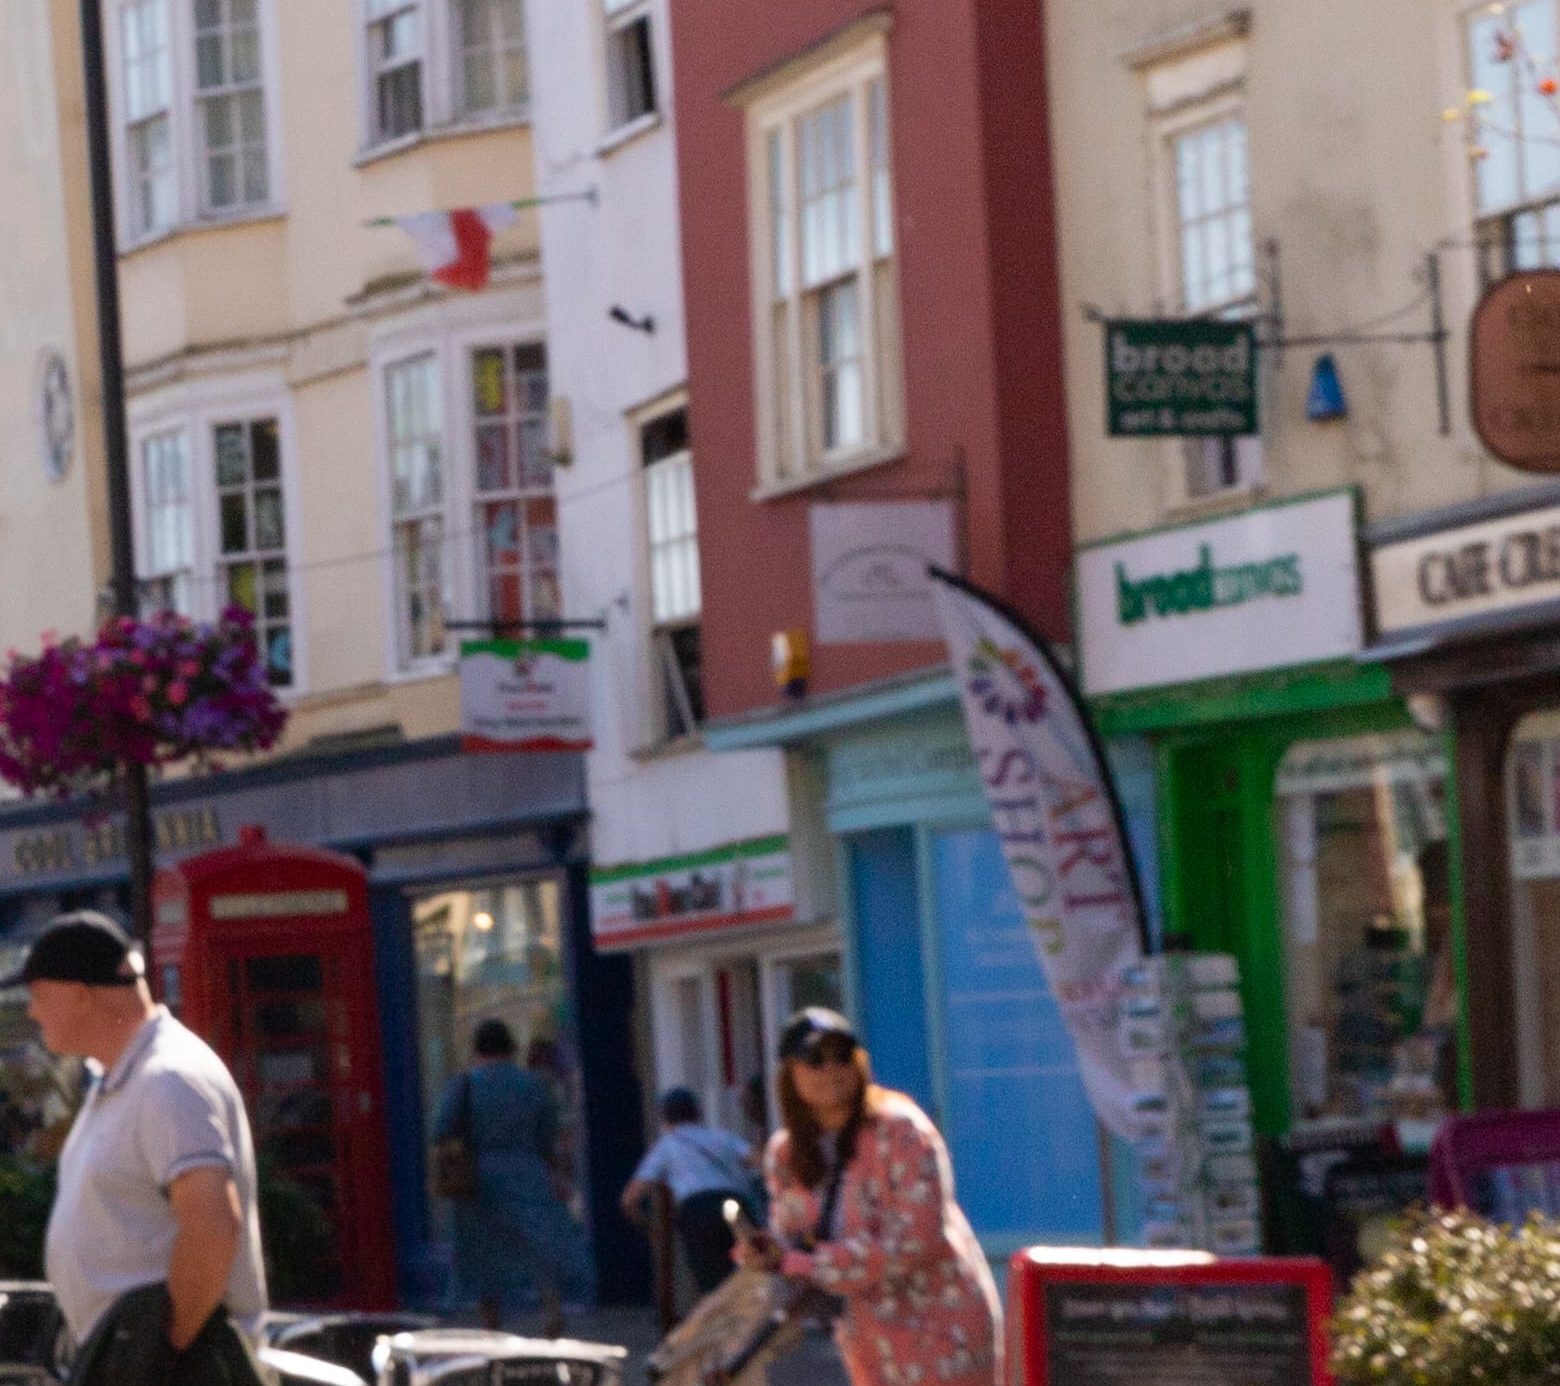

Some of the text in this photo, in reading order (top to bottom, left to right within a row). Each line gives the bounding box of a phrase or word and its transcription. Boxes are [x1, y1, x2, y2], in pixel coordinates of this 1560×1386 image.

[1112, 332, 1249, 373] broad
[974, 745, 1065, 955] SHOP
[1038, 768, 1124, 919] ART
